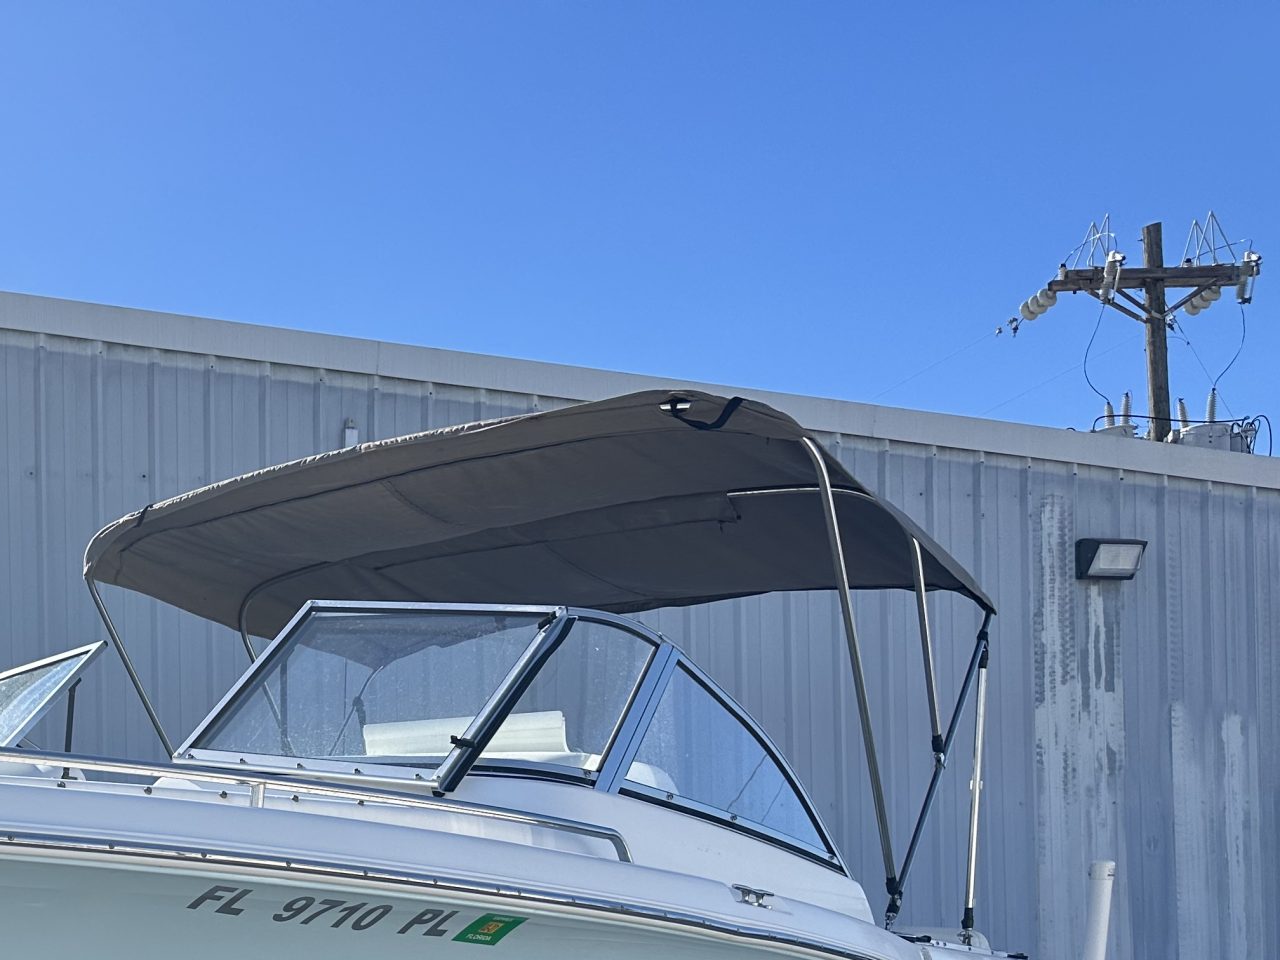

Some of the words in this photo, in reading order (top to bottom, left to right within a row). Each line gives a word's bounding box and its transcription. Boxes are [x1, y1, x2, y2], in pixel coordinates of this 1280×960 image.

[186, 885, 254, 916] FL
[272, 896, 394, 931] 9710
[397, 908, 460, 937] PL
[465, 933, 493, 941] FLORIDA
